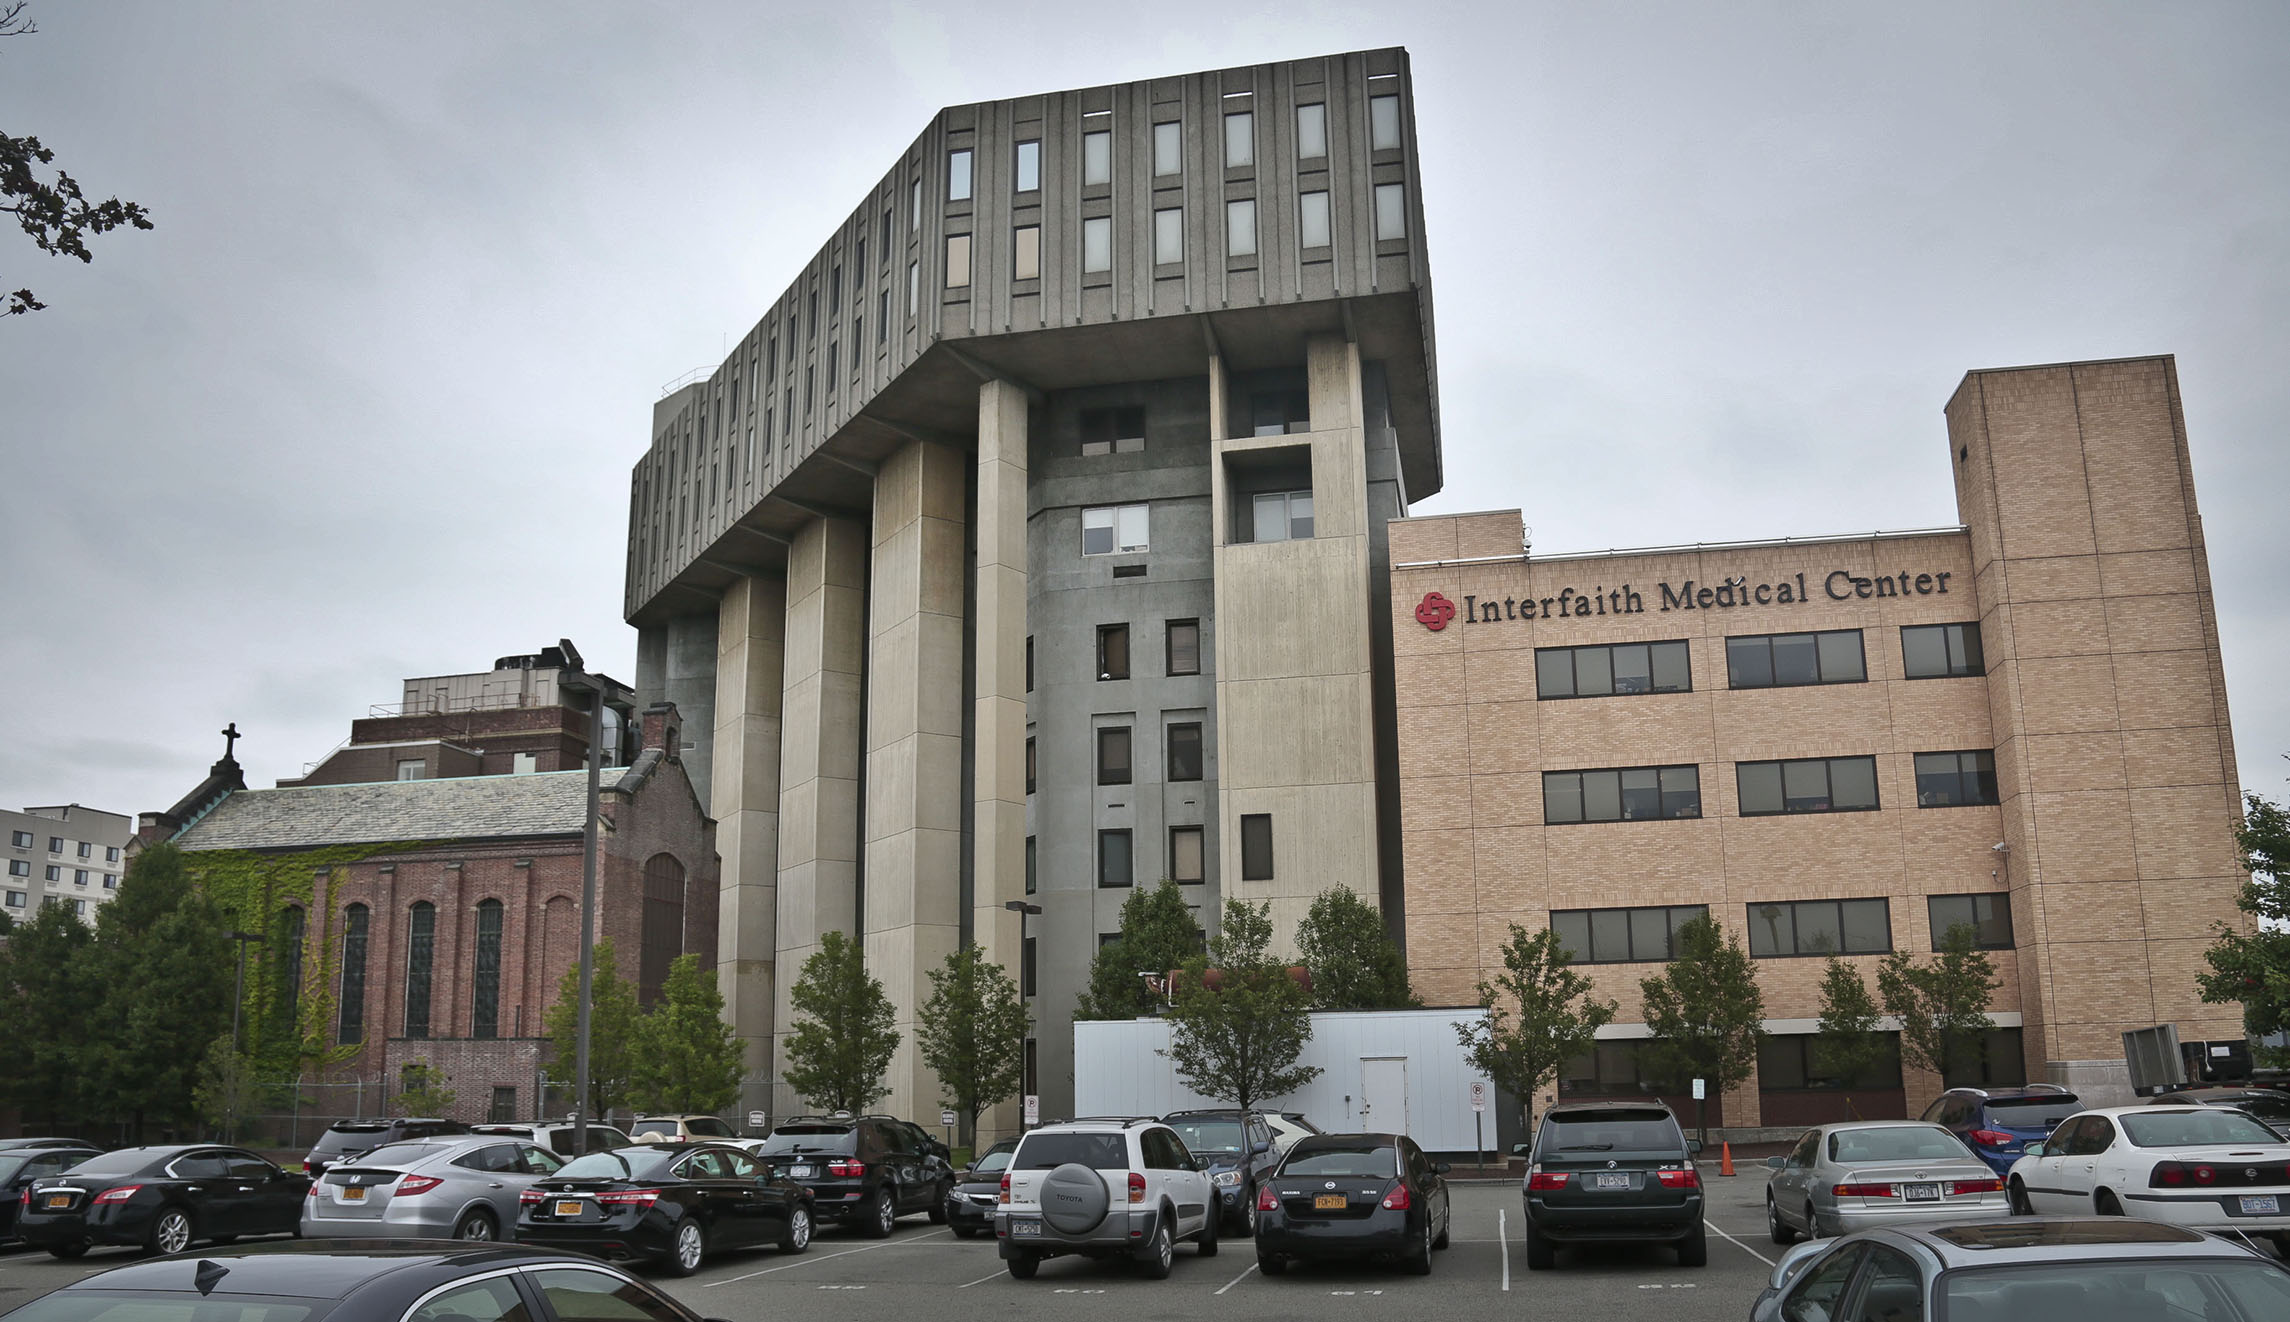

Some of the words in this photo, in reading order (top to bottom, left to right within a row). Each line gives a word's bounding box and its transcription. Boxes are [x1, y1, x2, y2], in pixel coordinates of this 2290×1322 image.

[1464, 584, 1645, 624] Interfaith
[1658, 572, 1809, 611] Medical
[1825, 570, 1952, 601] Center
[1056, 1193, 1083, 1203] TOYOTA
